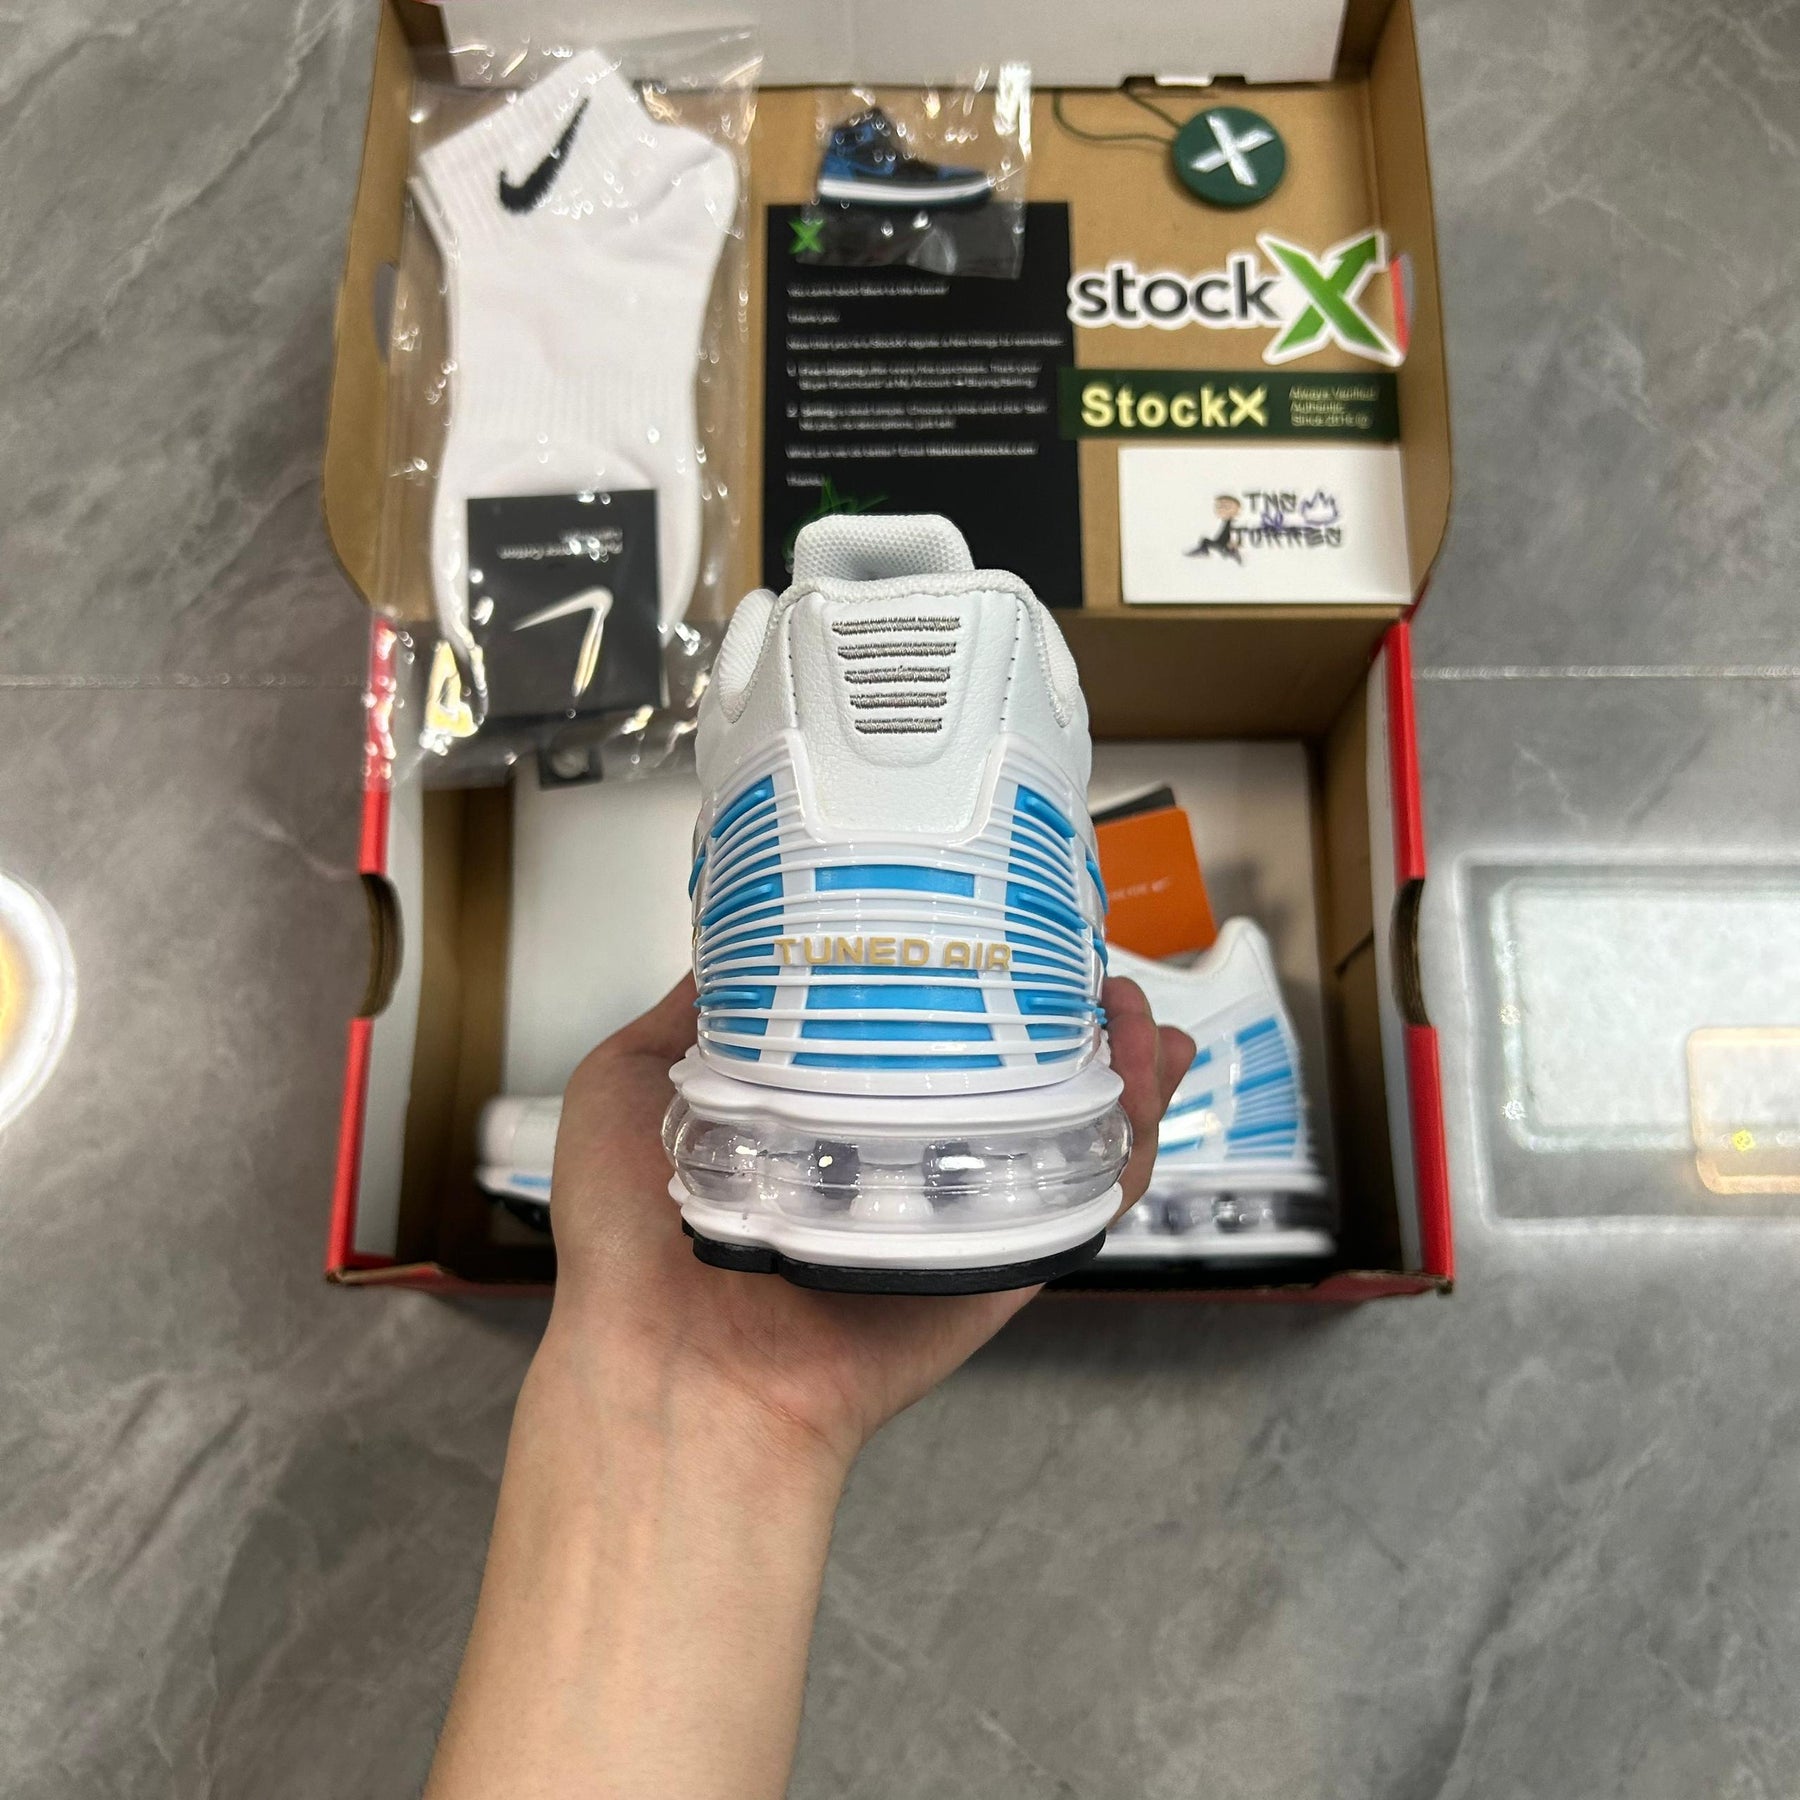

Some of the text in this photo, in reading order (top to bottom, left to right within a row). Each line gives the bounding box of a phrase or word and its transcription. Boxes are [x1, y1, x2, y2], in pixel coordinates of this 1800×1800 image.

[1081, 382, 1268, 427] StockX
[774, 937, 1012, 970] TUNED AIR
